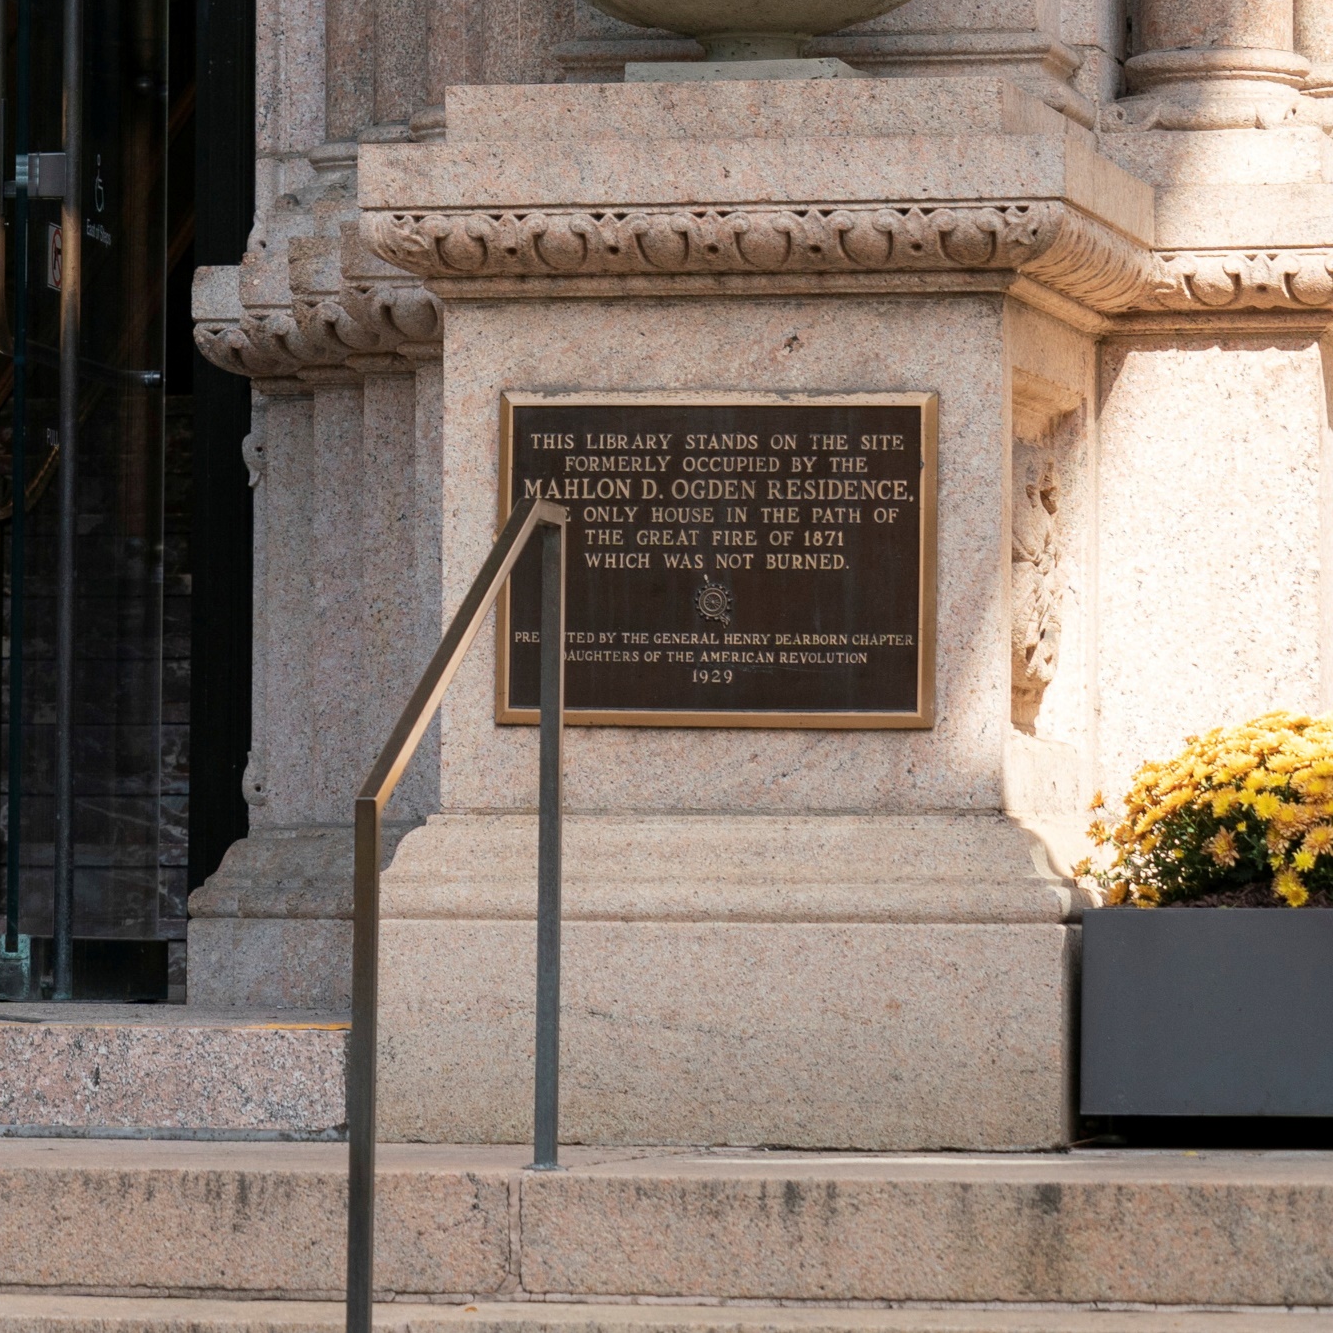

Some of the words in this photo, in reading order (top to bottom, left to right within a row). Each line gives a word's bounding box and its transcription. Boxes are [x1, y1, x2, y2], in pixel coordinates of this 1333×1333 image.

[530, 434, 574, 450] THIS
[586, 434, 673, 450] LIBRARY
[685, 434, 758, 450] STANDS
[770, 434, 797, 450] ON
[809, 434, 848, 450] THE
[861, 435, 904, 451] SITE
[564, 456, 672, 472] FORMERLY
[683, 456, 780, 472] OCCUPIED
[791, 457, 818, 472] BY
[829, 457, 868, 473] THE
[523, 478, 632, 499] MAHLON
[641, 478, 664, 500] D.
[671, 479, 757, 500] OGDEN
[767, 480, 914, 503] RESIDENCE,
[583, 506, 638, 523] ONLY
[651, 507, 714, 523] HOUSE
[726, 507, 748, 523] IN
[761, 507, 800, 523] THE
[812, 508, 861, 524] PATH
[874, 508, 899, 523] OF
[585, 529, 624, 545] THE
[636, 530, 700, 546] GREAT
[712, 530, 757, 546] FIRE
[769, 530, 794, 546] OF
[803, 531, 844, 546] 1871
[585, 553, 650, 569] WHICH
[663, 553, 703, 569] WAS
[716, 554, 754, 570] NOT
[766, 554, 850, 570] BURNED.
[514, 632, 595, 644] PRETED
[599, 632, 617, 644] BY
[622, 632, 649, 644] THE
[653, 632, 719, 644] GENERAL
[724, 633, 771, 645] HENRY
[775, 633, 848, 646] DEARBORN
[852, 634, 914, 646] CHAPTER
[644, 651, 662, 662] OF
[666, 651, 694, 663] THE
[700, 650, 774, 664] AMERICAN
[780, 652, 868, 664] REVOLUTION
[693, 670, 733, 684] 1929
